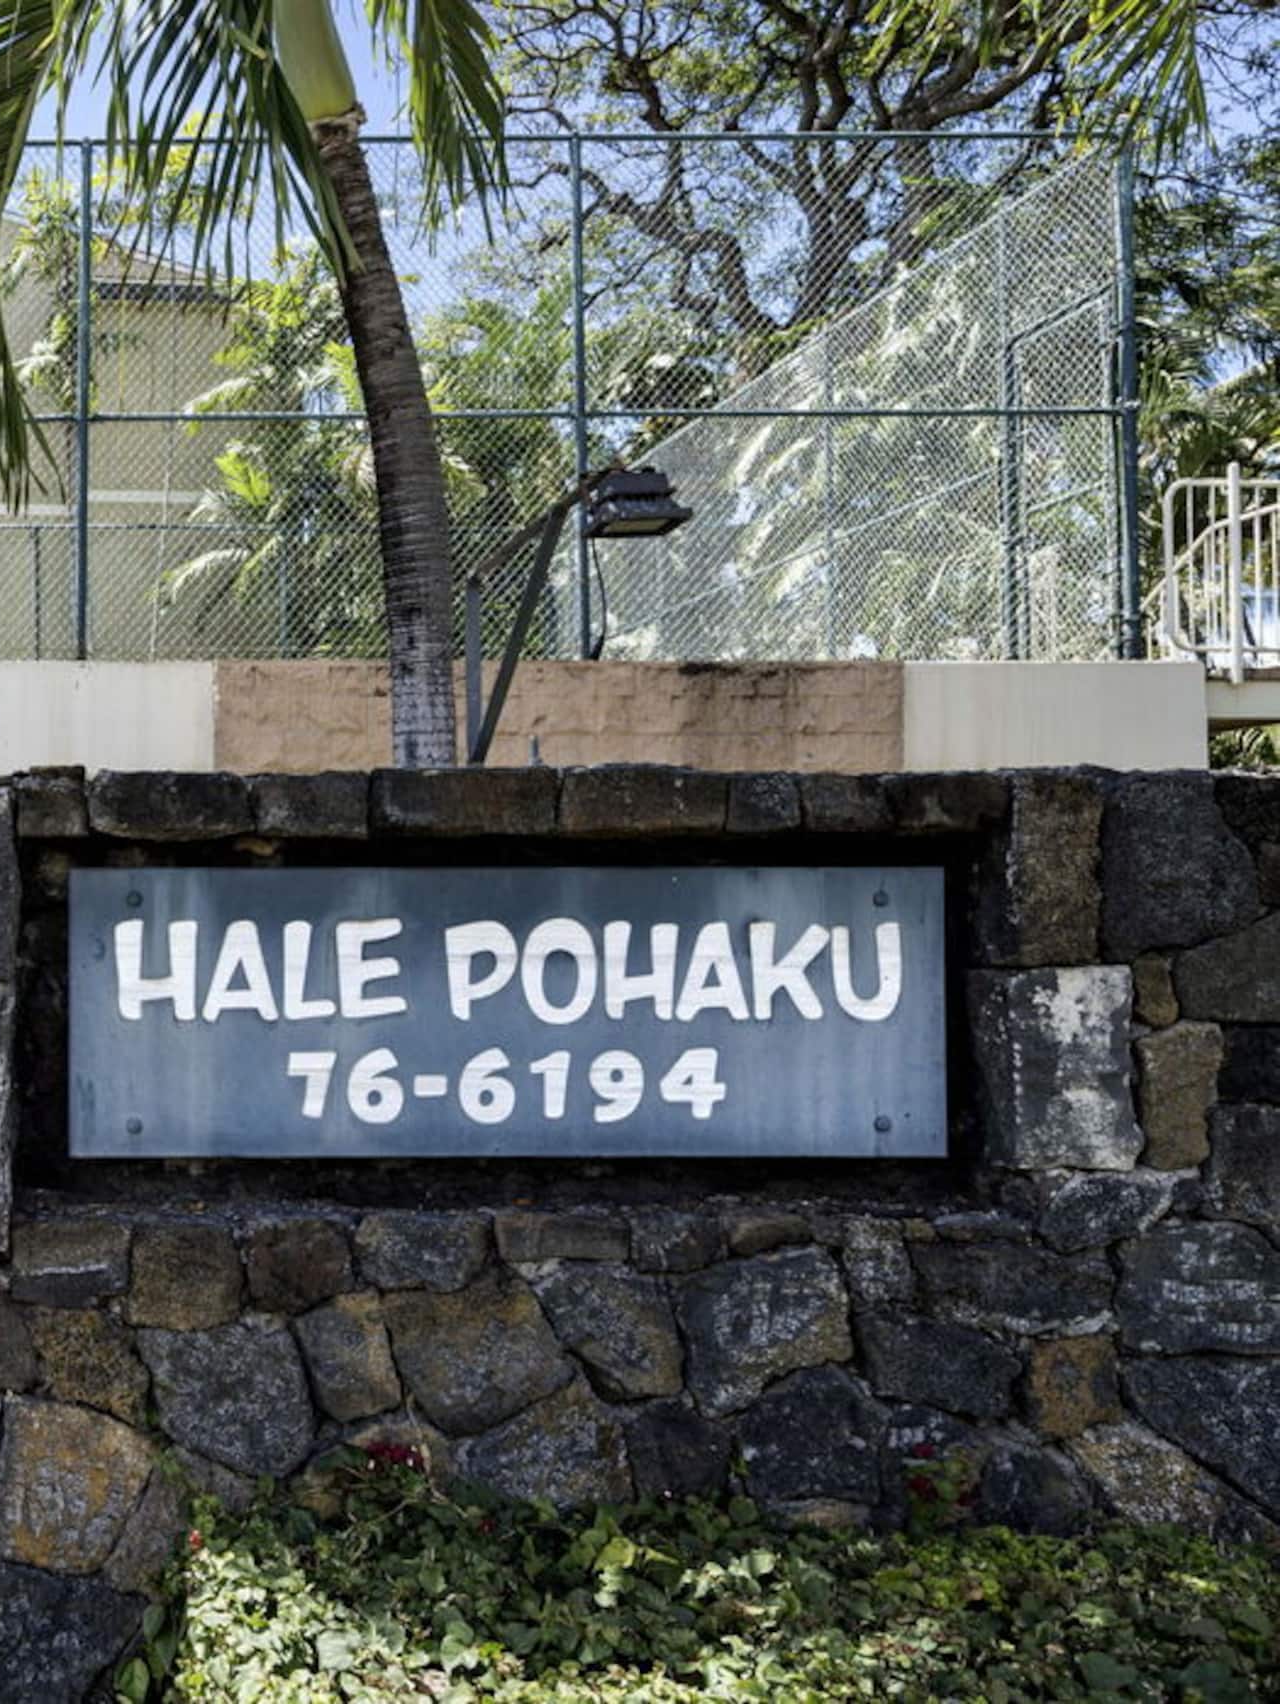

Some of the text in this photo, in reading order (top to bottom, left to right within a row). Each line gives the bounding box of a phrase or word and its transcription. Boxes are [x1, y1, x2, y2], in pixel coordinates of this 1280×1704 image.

[114, 917, 903, 1025] HALE POHAKU
[286, 1047, 727, 1124] 76-6194
